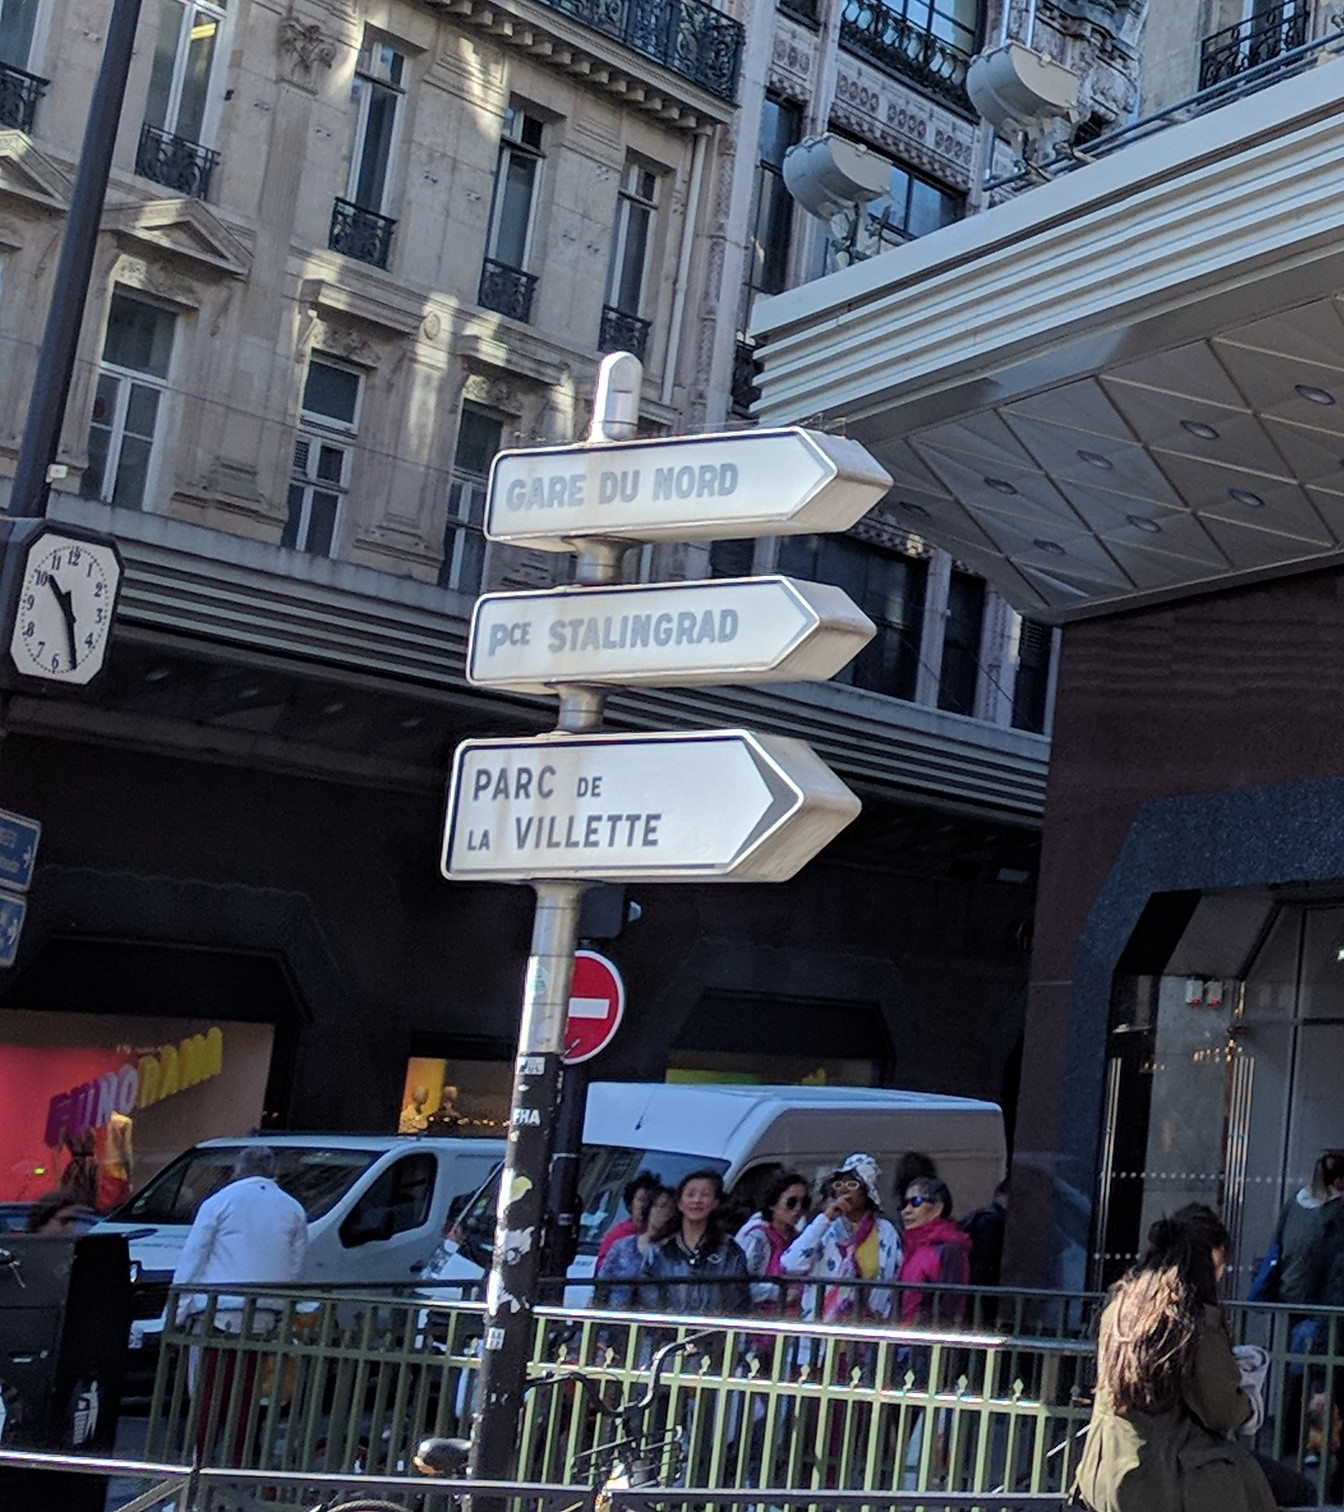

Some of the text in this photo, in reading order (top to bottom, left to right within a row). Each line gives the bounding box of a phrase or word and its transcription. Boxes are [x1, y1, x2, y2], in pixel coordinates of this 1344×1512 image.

[506, 462, 739, 511] GARE DU NORD
[51, 555, 62, 570] 11
[67, 549, 81, 566] 12
[35, 569, 50, 586] 10
[86, 562, 95, 577] 1
[94, 582, 103, 597] 2
[26, 595, 35, 610] 9
[95, 608, 103, 624] 3
[25, 622, 35, 637] 8
[548, 608, 739, 653] STALINGRAD
[84, 632, 94, 648] 4
[36, 641, 46, 658] 7
[51, 653, 60, 669] 6
[472, 765, 602, 801] PARC DE
[467, 813, 661, 851] LA VILLETTE
